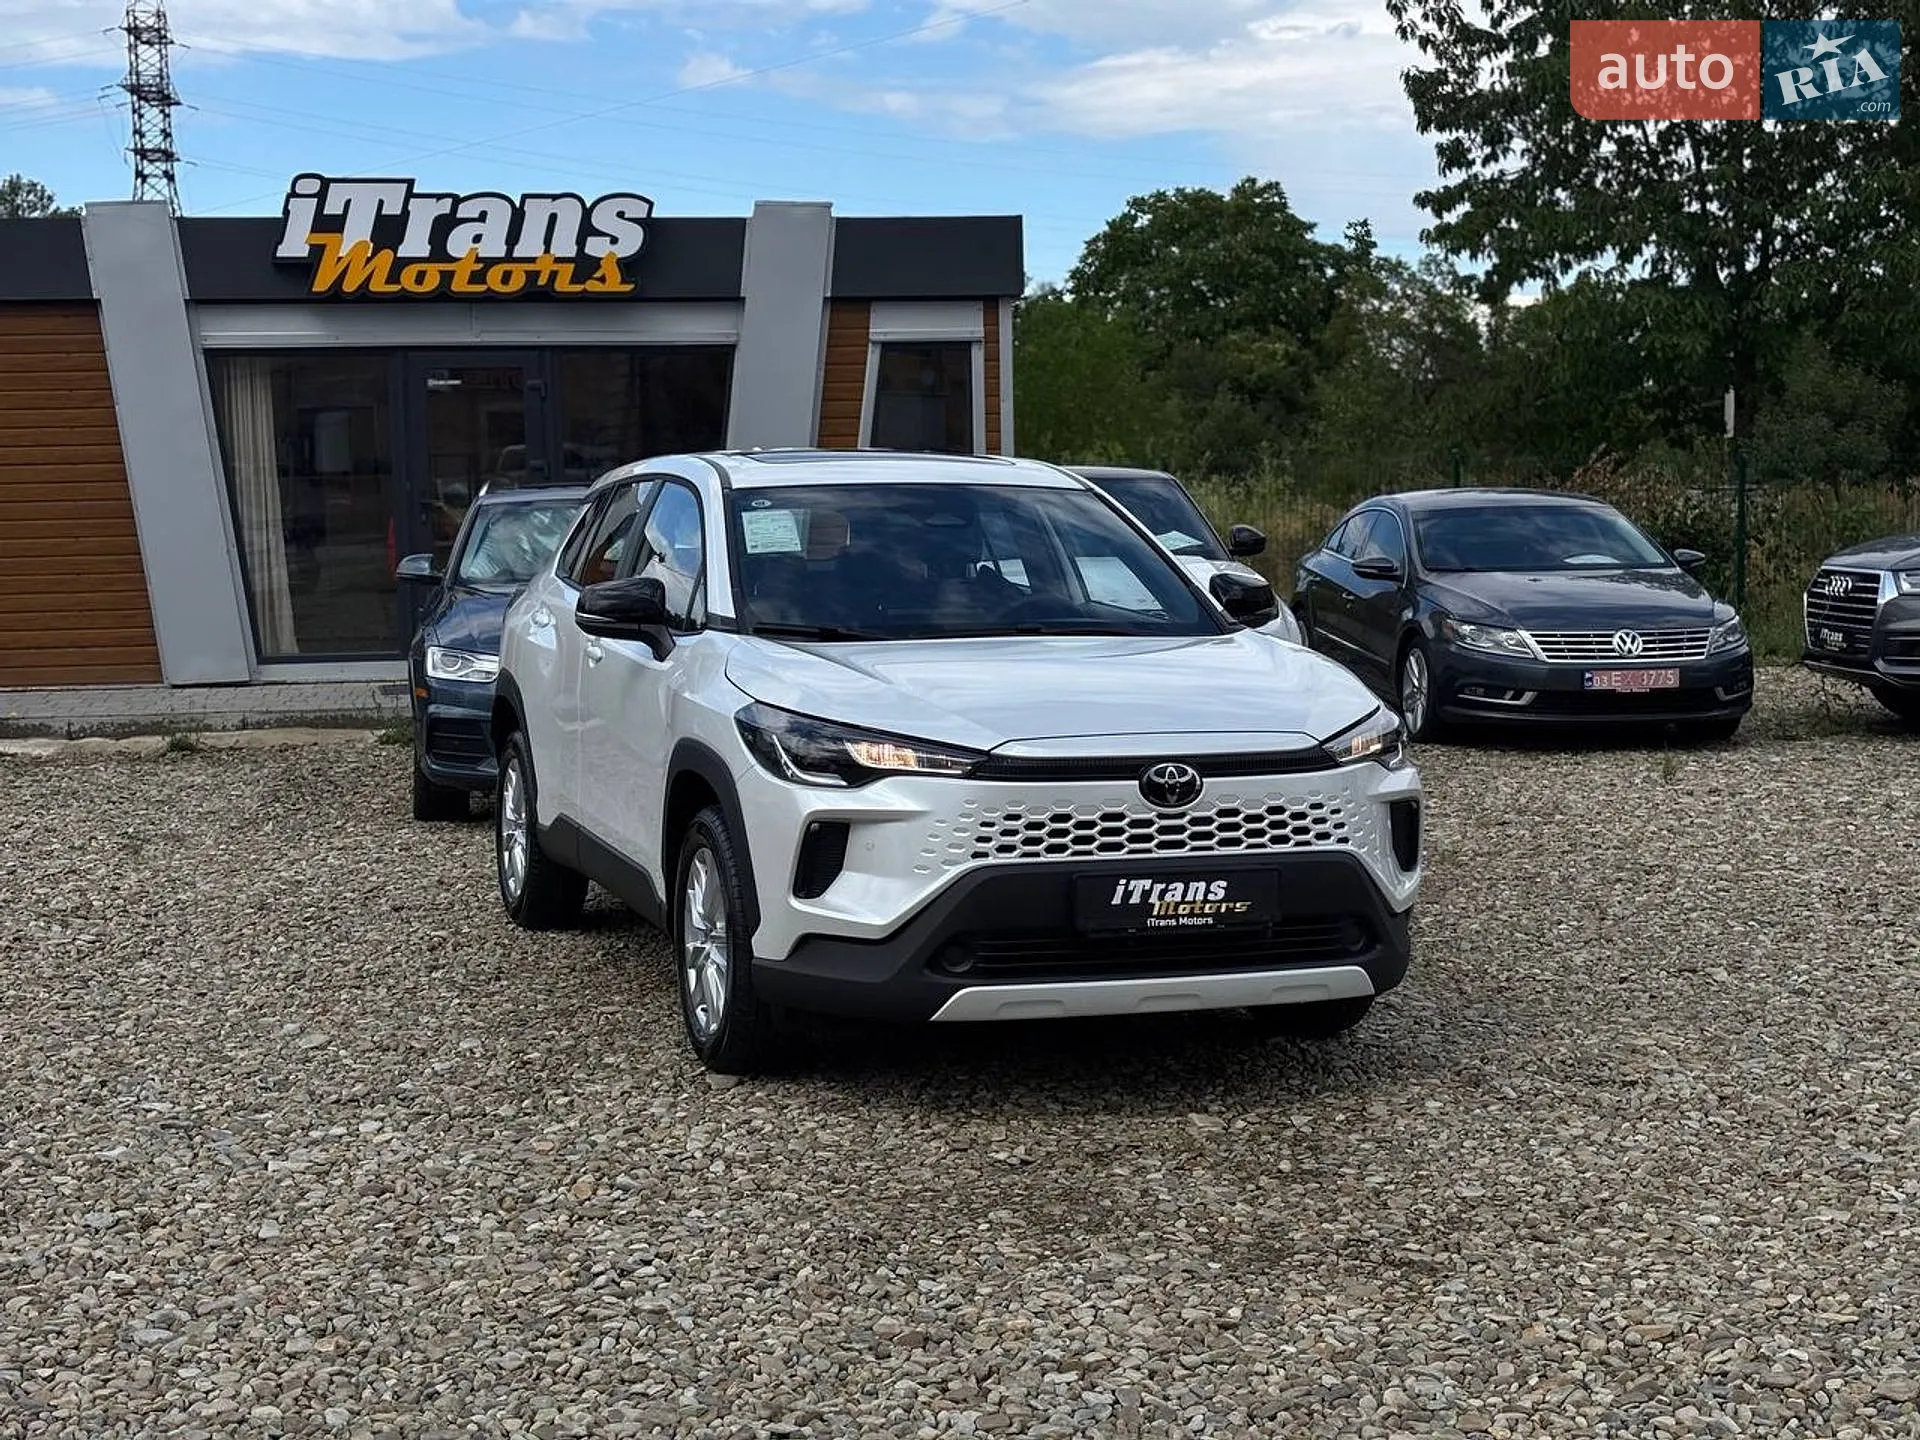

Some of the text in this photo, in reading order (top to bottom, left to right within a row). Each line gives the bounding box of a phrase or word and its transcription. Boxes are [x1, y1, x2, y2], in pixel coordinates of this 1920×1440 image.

[275, 176, 654, 259] iTrans
[305, 232, 635, 293] Motors
[1111, 878, 1228, 905] iTrans
[1147, 915, 1213, 927] iTrans Motors
[1151, 900, 1252, 917] Motors
